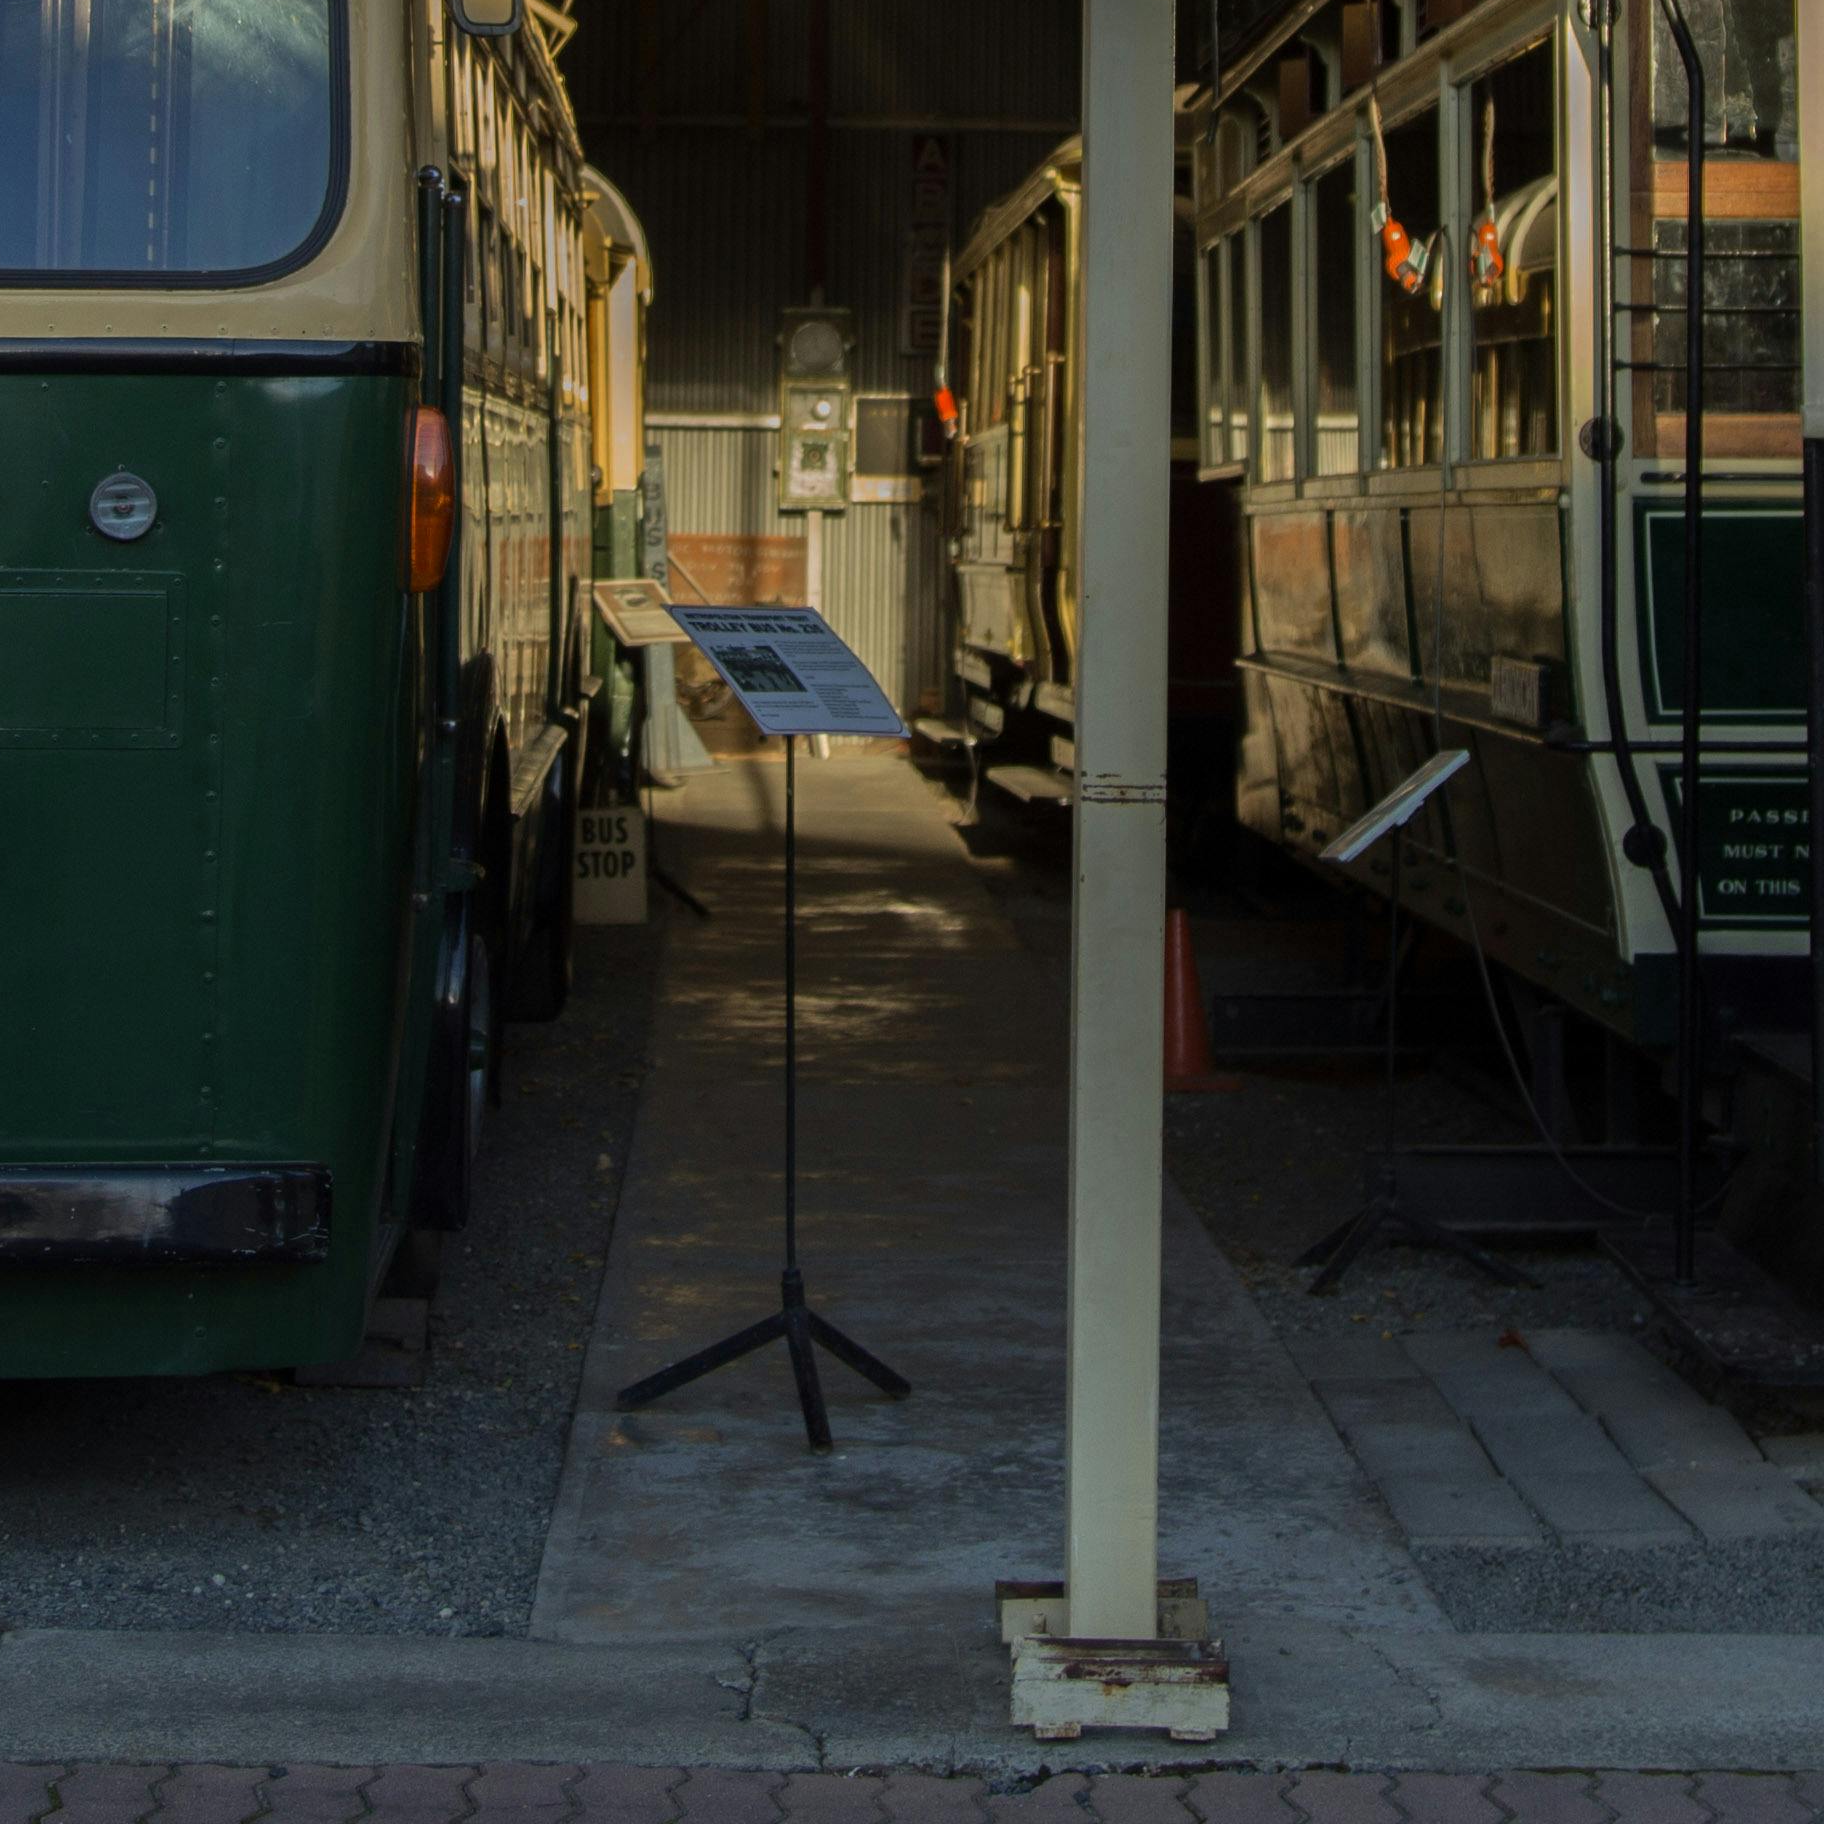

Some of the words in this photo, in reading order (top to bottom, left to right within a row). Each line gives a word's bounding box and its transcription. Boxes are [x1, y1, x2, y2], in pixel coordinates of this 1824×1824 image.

[687, 621, 749, 633] TROLLEY
[747, 622, 782, 634] BUS
[582, 817, 629, 844] BUS
[1723, 844, 1784, 860] MUST
[577, 850, 635, 879] STOP
[1717, 878, 1747, 896] ON
[1754, 878, 1801, 897] THIS
